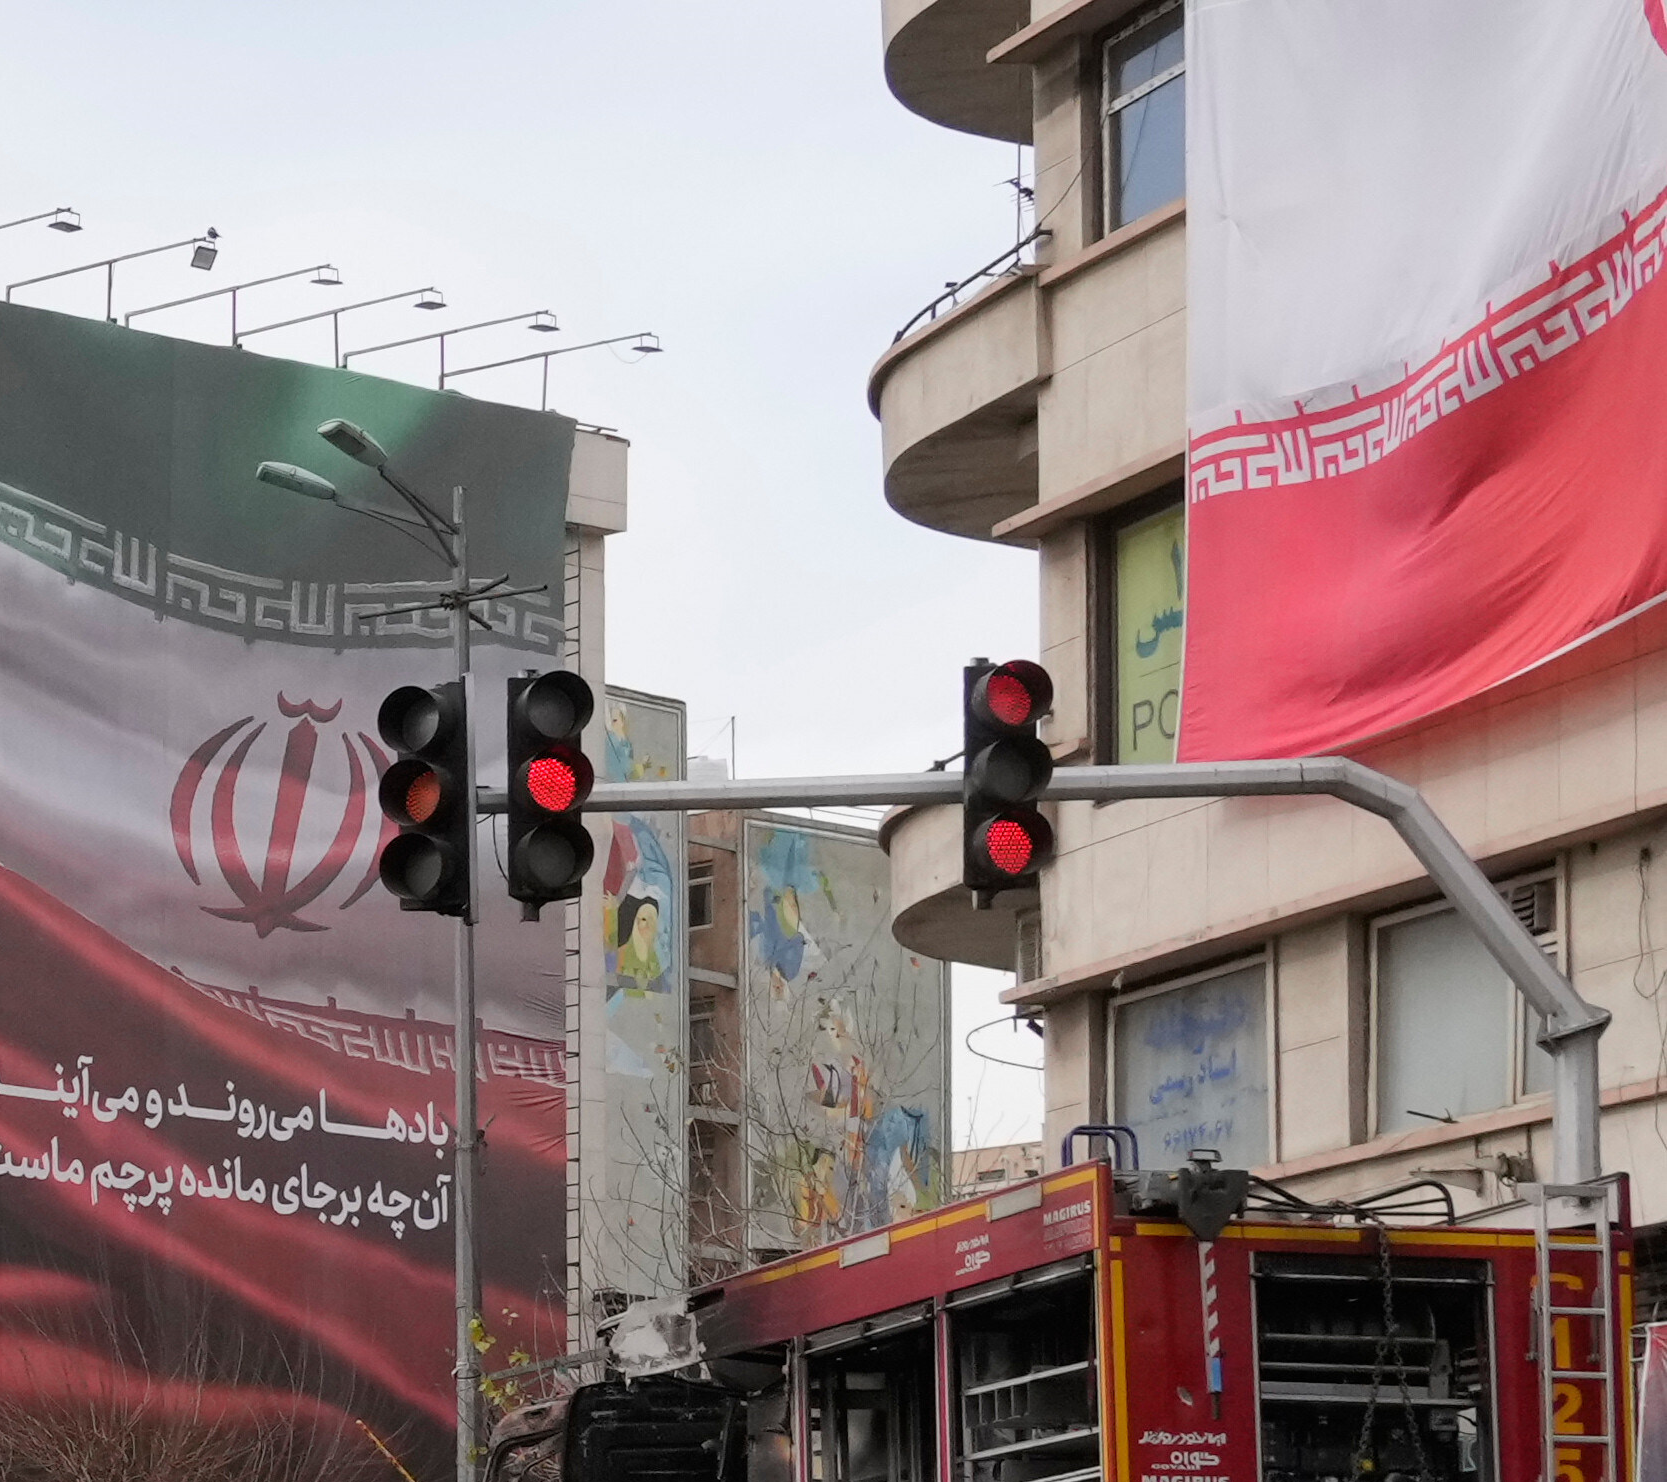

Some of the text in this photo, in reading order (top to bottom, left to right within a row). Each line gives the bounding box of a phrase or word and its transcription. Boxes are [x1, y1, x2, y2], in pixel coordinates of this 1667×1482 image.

[143, 1097, 162, 1129] و
[320, 1088, 449, 1160] بادها
[90, 1155, 173, 1215] پرچم
[179, 1155, 266, 1206] مانده
[1043, 1200, 1091, 1226] MAGIRUS
